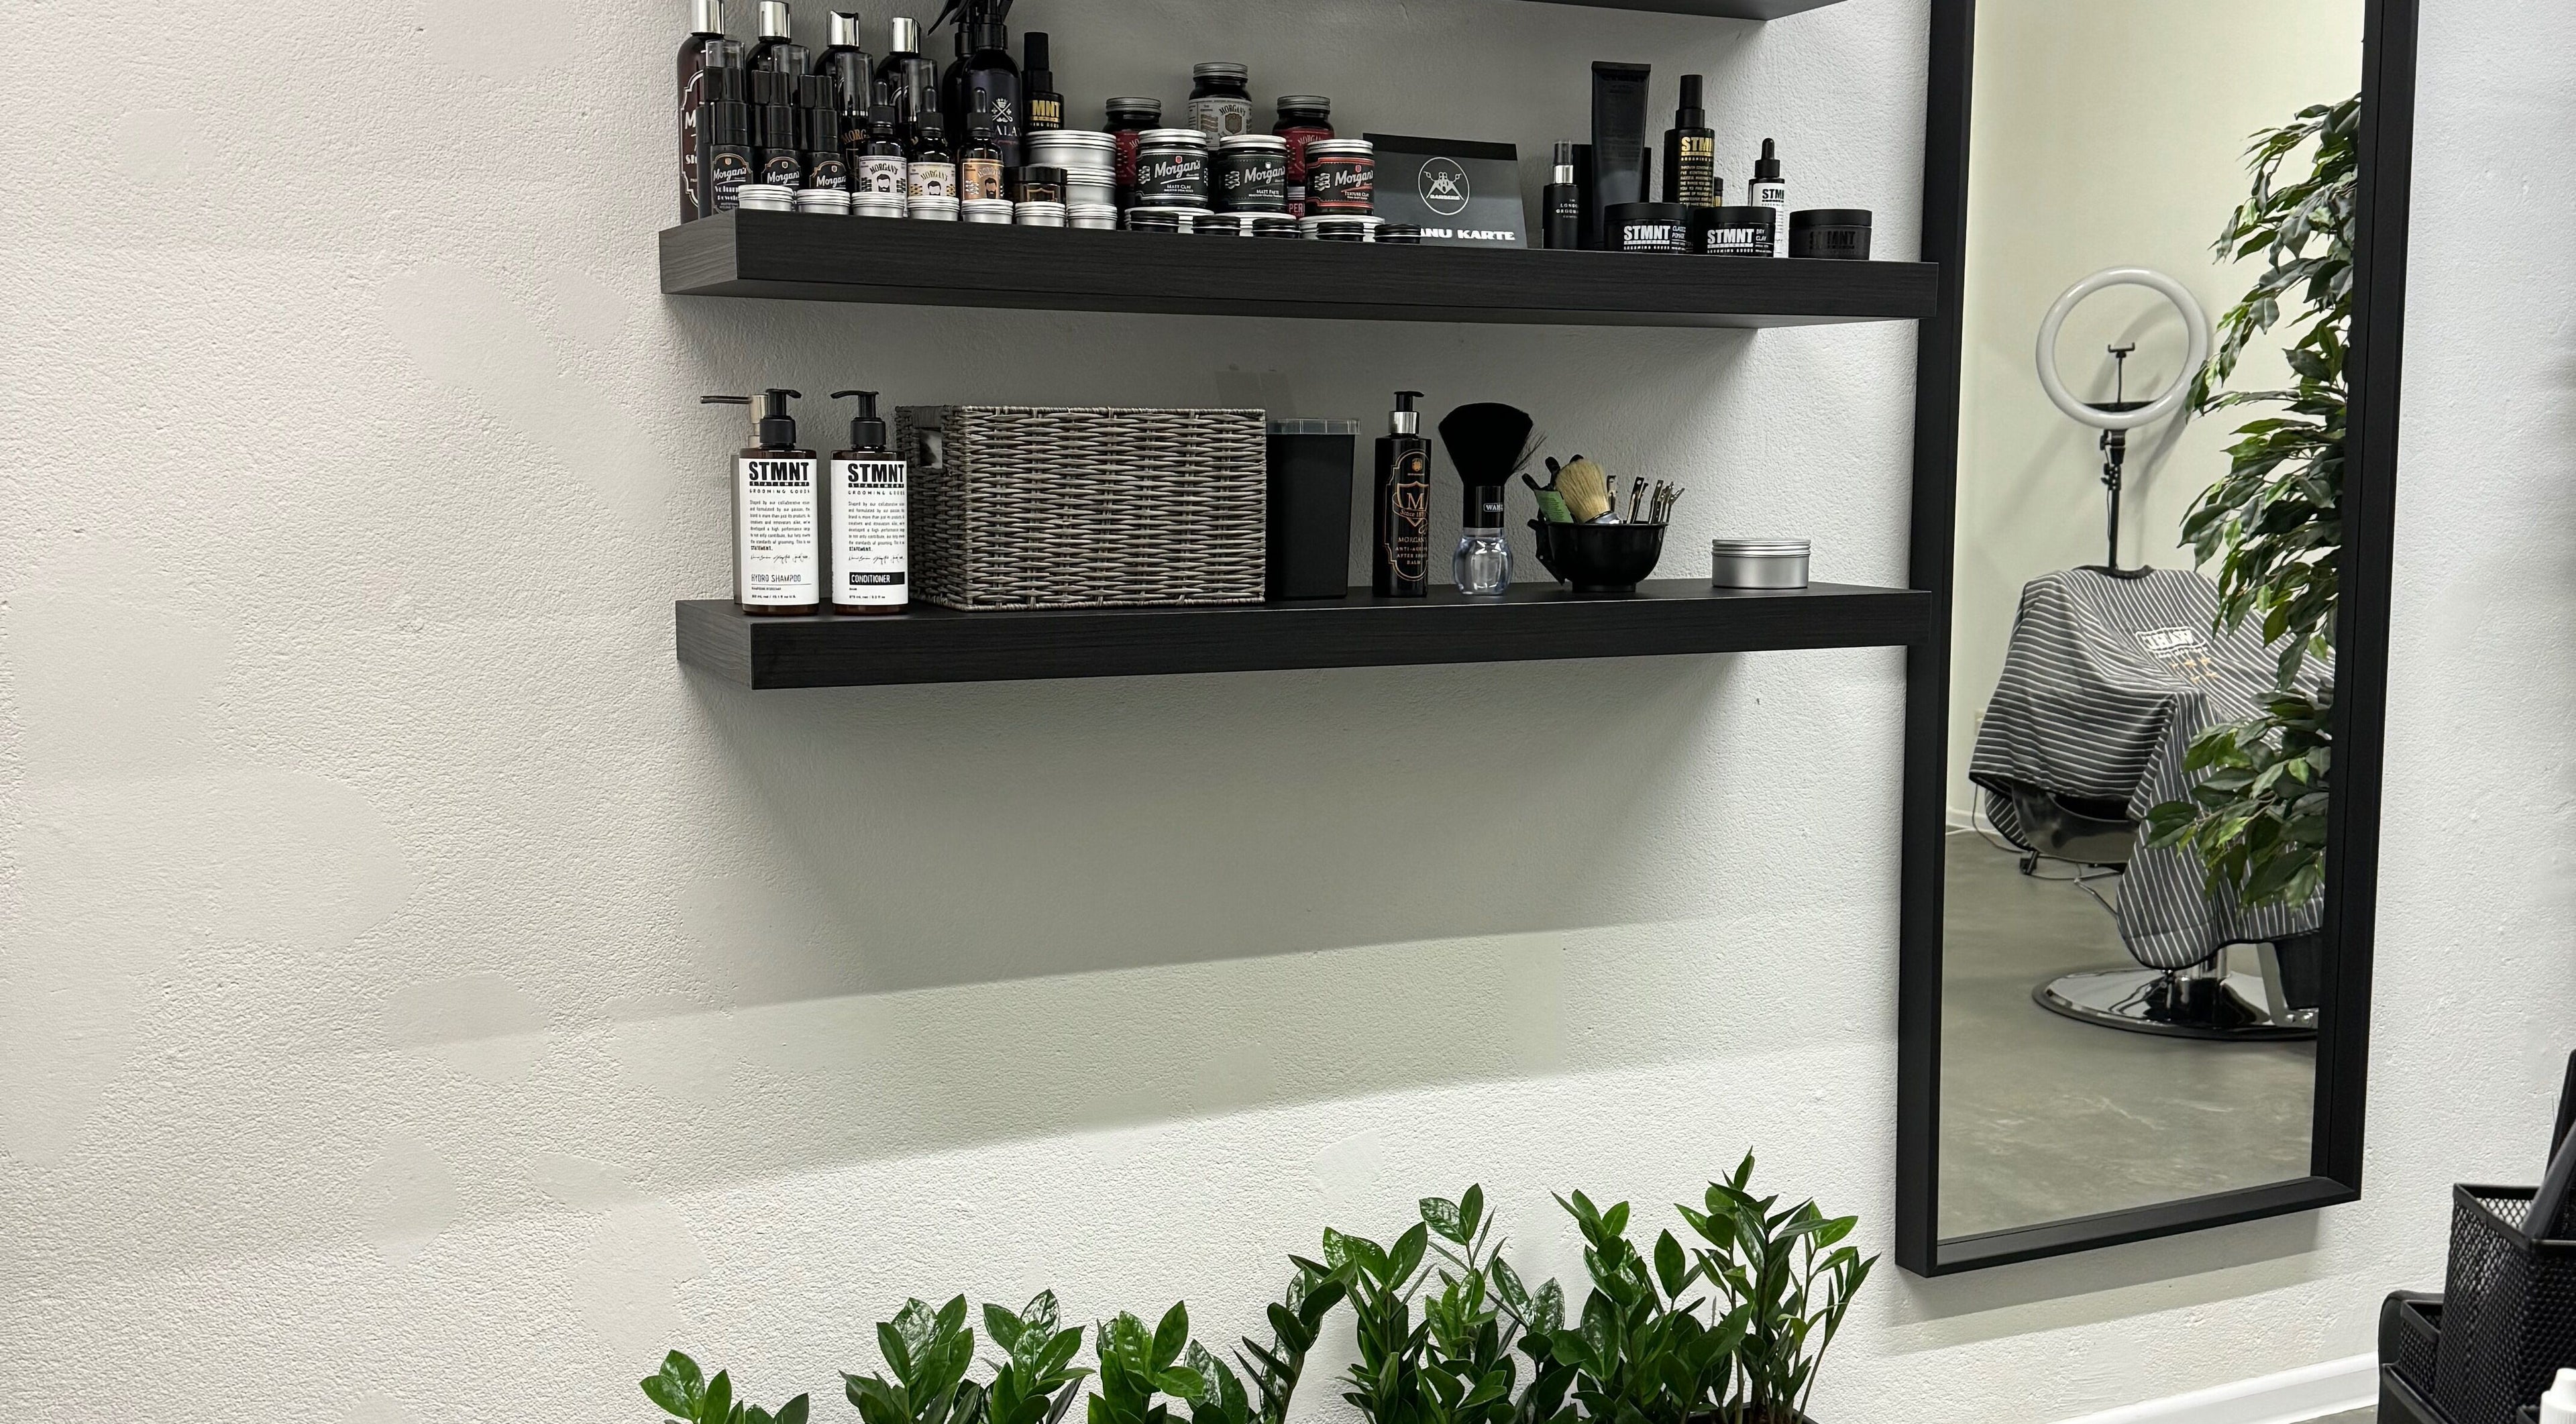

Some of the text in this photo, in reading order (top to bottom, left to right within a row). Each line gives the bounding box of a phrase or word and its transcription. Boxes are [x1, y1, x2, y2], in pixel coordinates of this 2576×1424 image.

[1032, 100, 1060, 117] MNT
[713, 167, 747, 181] Morgan's
[869, 163, 898, 174] MORGAN'S
[1155, 160, 1201, 178] Morgan's
[816, 175, 847, 188] Morgan
[1420, 228, 1515, 241] ANU KARTE
[1623, 225, 1671, 241] STMNT
[1707, 229, 1755, 244] STMNT
[749, 461, 809, 480] STMNT
[848, 463, 904, 482] STMNT
[1407, 493, 1424, 509] M
[851, 574, 891, 583] CONDITIONER
